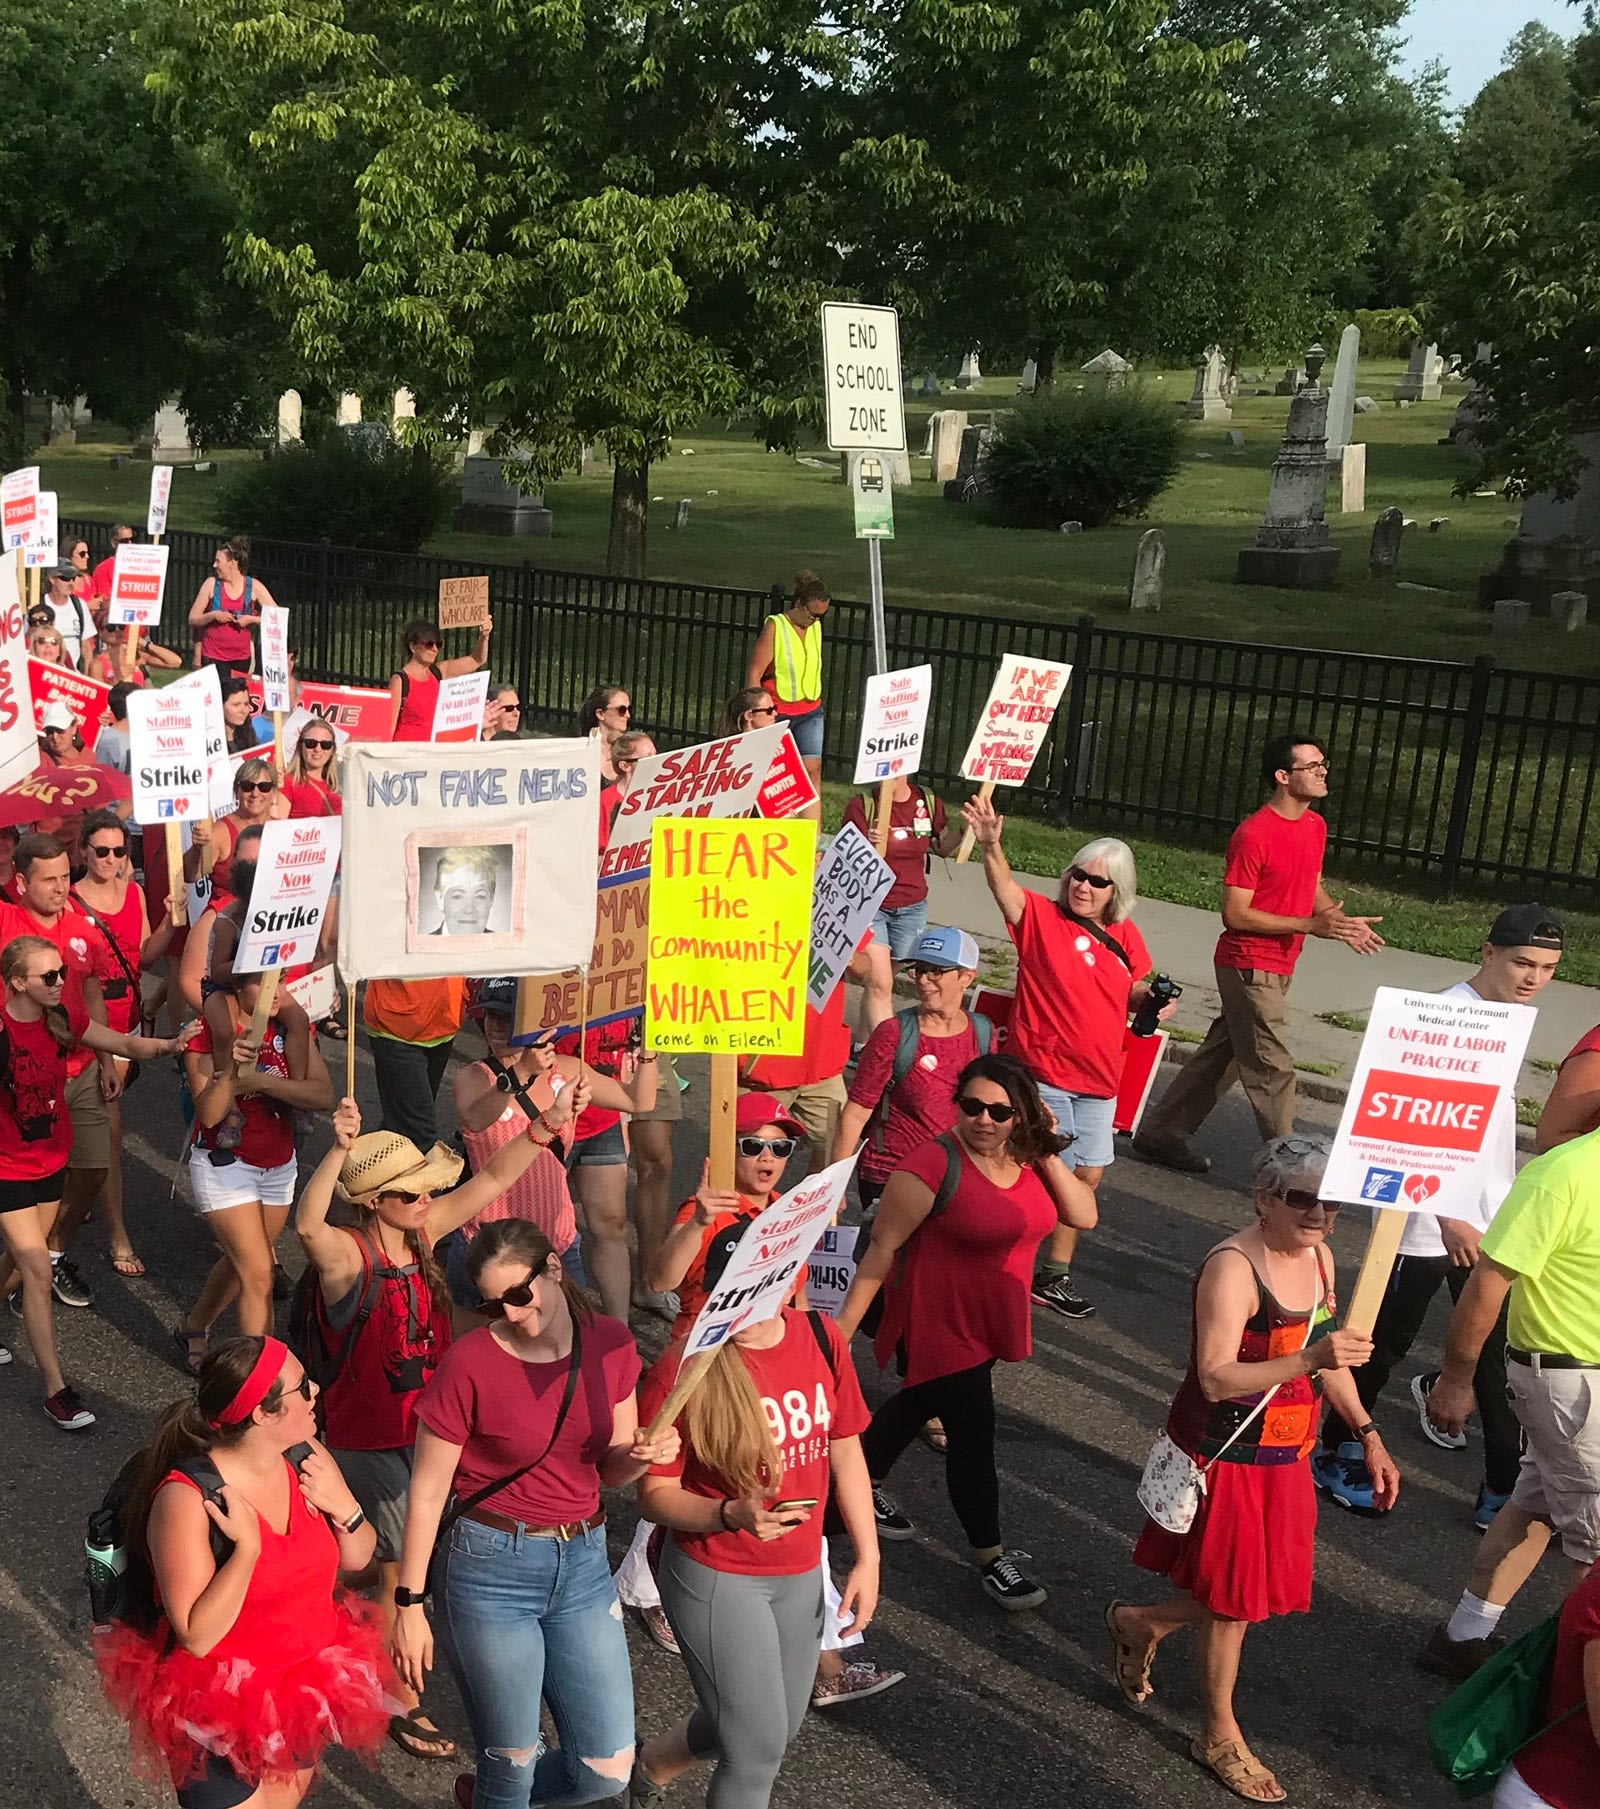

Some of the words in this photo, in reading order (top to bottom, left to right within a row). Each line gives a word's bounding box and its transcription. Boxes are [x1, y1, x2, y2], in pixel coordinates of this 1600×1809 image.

[848, 323, 878, 350] END
[836, 364, 894, 392] SCHOOL
[849, 407, 888, 433] ZONE
[6, 504, 35, 519] STRIKE
[120, 582, 157, 594] STRIKE
[459, 579, 480, 595] FAIR
[454, 595, 476, 606] THOSE
[442, 607, 462, 626] WHO
[462, 605, 485, 622] CARE
[42, 670, 98, 700] PATIENTS
[890, 677, 912, 690] Safe
[1011, 667, 1029, 685] IF
[1031, 669, 1061, 690] WE
[47, 688, 86, 711] Before
[155, 697, 181, 709] Safe
[879, 689, 919, 706] Staffing
[1009, 685, 1049, 705] ARE
[146, 714, 192, 729] Staffing
[884, 708, 909, 722] Now
[989, 699, 1019, 719] OUT
[1016, 705, 1056, 724] HERE
[156, 735, 185, 749] Now
[865, 732, 919, 756] Strike
[980, 741, 1035, 762] WRONG
[654, 737, 743, 783] SAFE
[968, 758, 987, 777] IN
[140, 766, 202, 789] Strike
[367, 770, 428, 808] NOT
[439, 767, 508, 808] FAKE
[518, 767, 588, 805] NEWS
[620, 763, 754, 815] STAFFING
[763, 772, 797, 800] PROFITS!
[293, 826, 321, 843] Safe
[276, 848, 326, 866] Staffing
[663, 828, 798, 880] HEAR
[835, 827, 890, 894] EVERY
[280, 872, 314, 890] Now
[828, 856, 872, 912] BODY
[694, 885, 748, 919] the
[815, 874, 838, 905] HAS
[837, 905, 851, 925] A
[251, 905, 320, 934] Strike
[611, 937, 635, 966] DO
[649, 920, 803, 980] community
[649, 982, 796, 1025] WHALEN
[1404, 996, 1454, 1013] University
[1457, 1005, 1467, 1015] of
[1468, 1006, 1510, 1020] Vermont
[1417, 1013, 1455, 1027] Medical
[1458, 1019, 1490, 1031] Center
[655, 1033, 694, 1047] come
[703, 1034, 719, 1046] on
[729, 1028, 782, 1048] Eileen!
[1388, 1025, 1448, 1047] UNFAIR
[1453, 1034, 1507, 1054] LABOR
[1400, 1050, 1481, 1074] PRACTICE
[1367, 1091, 1485, 1131] STRIKE
[1349, 1139, 1385, 1152] Vermont
[1387, 1144, 1434, 1158] Federation
[1435, 1151, 1445, 1159] of
[1445, 1152, 1475, 1164] Nurses
[1359, 1153, 1367, 1161] &
[1368, 1154, 1398, 1166] Health
[1400, 1158, 1456, 1173] Professionals
[788, 1180, 833, 1210] Safe
[755, 1195, 835, 1240] Staffing
[752, 1233, 801, 1263] Now
[808, 1263, 850, 1292] Strik
[700, 1259, 799, 1322] Strike
